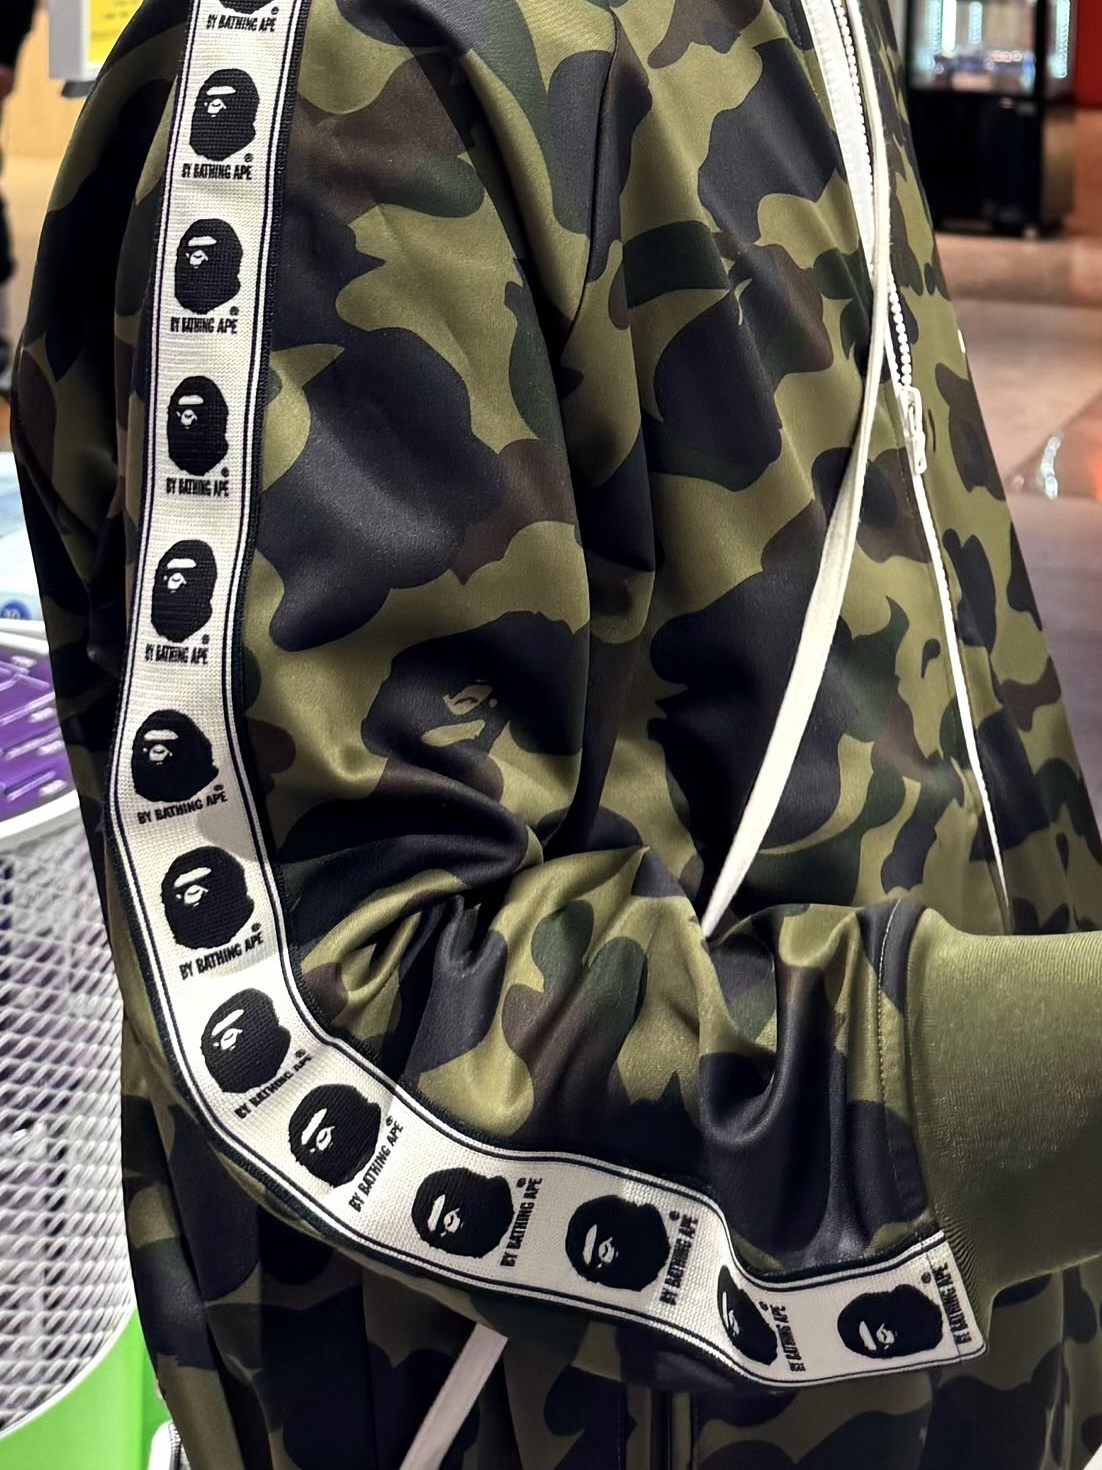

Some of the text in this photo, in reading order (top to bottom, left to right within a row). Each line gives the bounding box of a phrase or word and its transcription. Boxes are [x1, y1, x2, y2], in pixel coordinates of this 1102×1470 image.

[206, 14, 278, 33] BY BATHING APE
[181, 163, 253, 180] BY BATHING APE
[170, 317, 239, 335] BY BATHING APE
[166, 478, 229, 497] BY BATHING APE
[155, 645, 190, 663] BATHING
[190, 647, 209, 665] APE
[137, 790, 229, 825] BY BATHING APE
[179, 931, 265, 980] BY BATHING APE
[234, 1053, 314, 1120] BY BATHING APE
[348, 1119, 405, 1213] BY BATHING APE
[500, 1177, 543, 1268] BY BATHING APE
[659, 1286, 678, 1307] BY
[679, 1214, 699, 1240] APE
